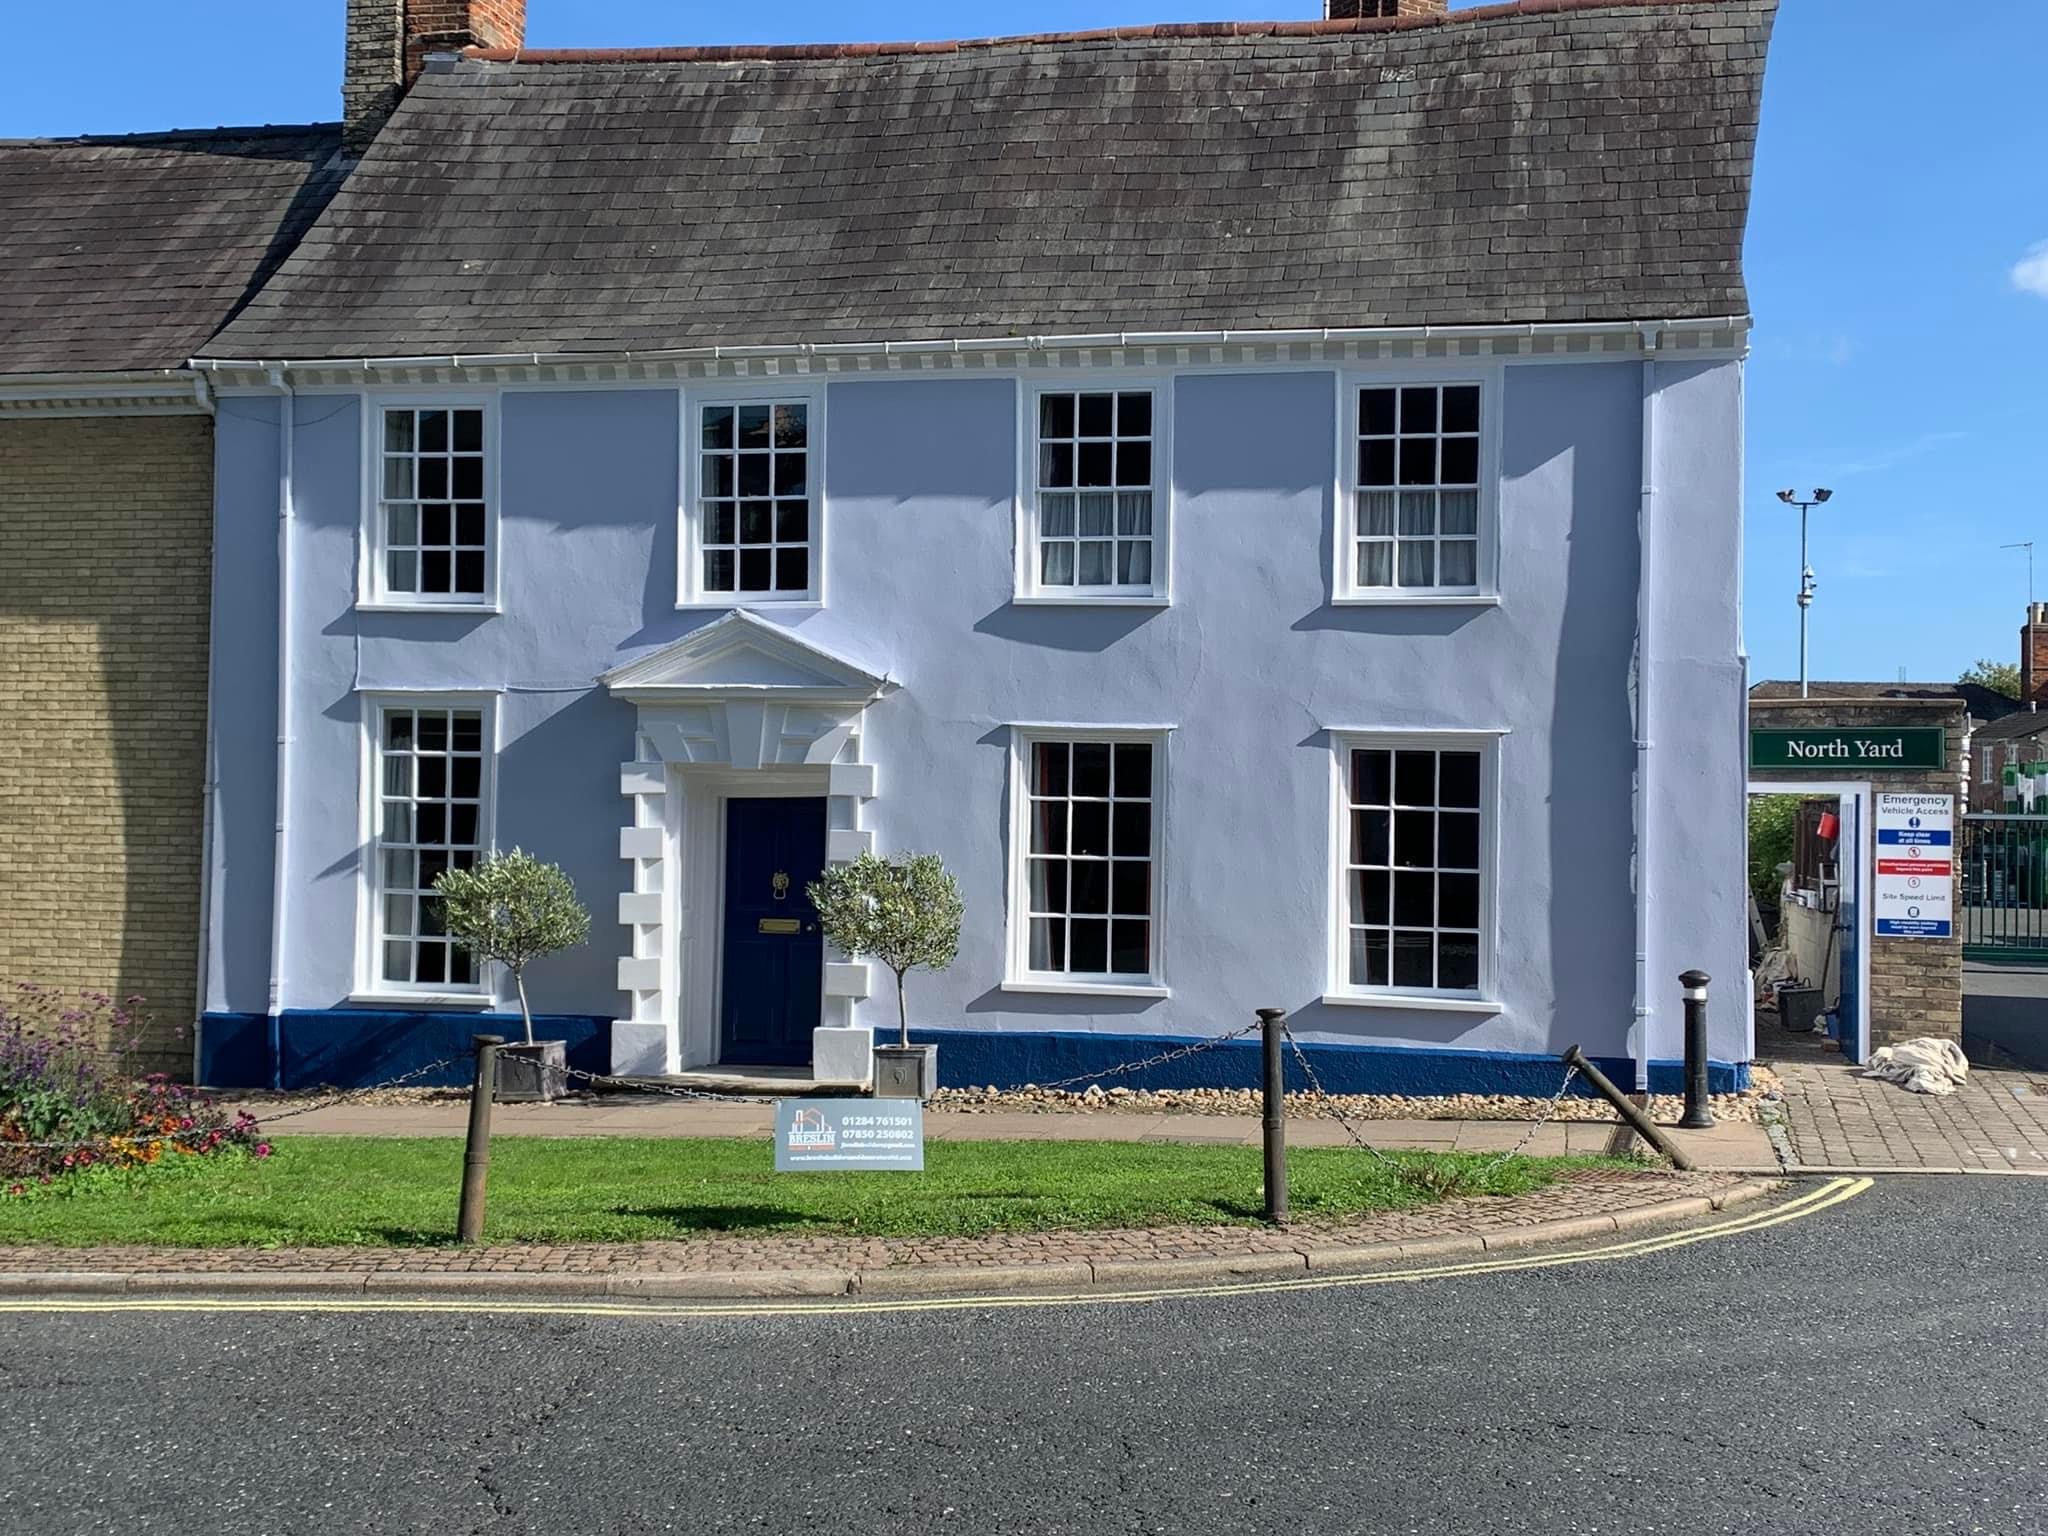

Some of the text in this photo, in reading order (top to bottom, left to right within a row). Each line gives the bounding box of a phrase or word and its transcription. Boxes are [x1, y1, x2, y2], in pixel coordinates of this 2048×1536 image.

[1787, 738, 1903, 758] North Yard
[1883, 794, 1948, 807] Emergency
[1882, 806, 1949, 816] Vehicle Access
[1899, 893, 1925, 902] Speed
[1926, 894, 1946, 902] Limit
[841, 1116, 913, 1126] 01284 761501
[789, 1134, 835, 1143] BRESLIN
[842, 1129, 874, 1139] 07850
